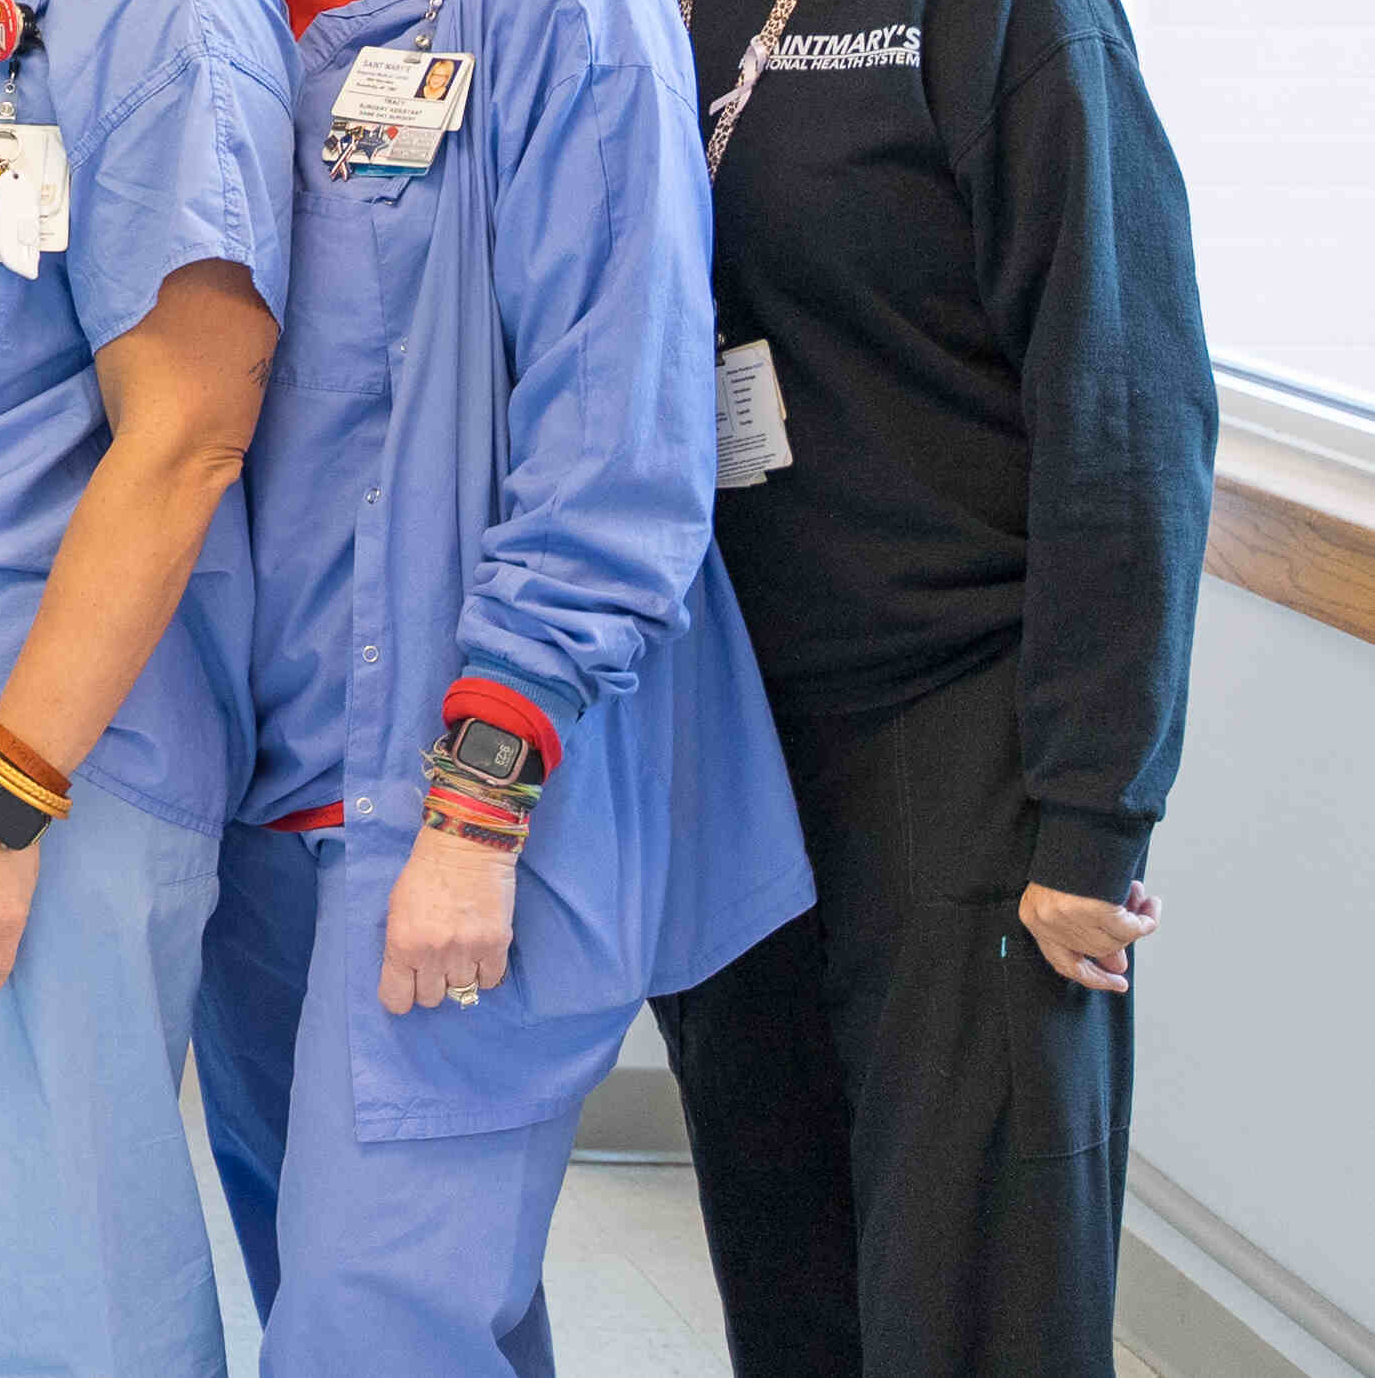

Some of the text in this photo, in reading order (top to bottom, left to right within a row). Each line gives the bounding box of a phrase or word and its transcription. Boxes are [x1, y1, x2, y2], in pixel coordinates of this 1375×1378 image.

[772, 24, 921, 56] INTMARY'S
[810, 55, 865, 70] HEALTH
[865, 52, 921, 68] SYSTEM
